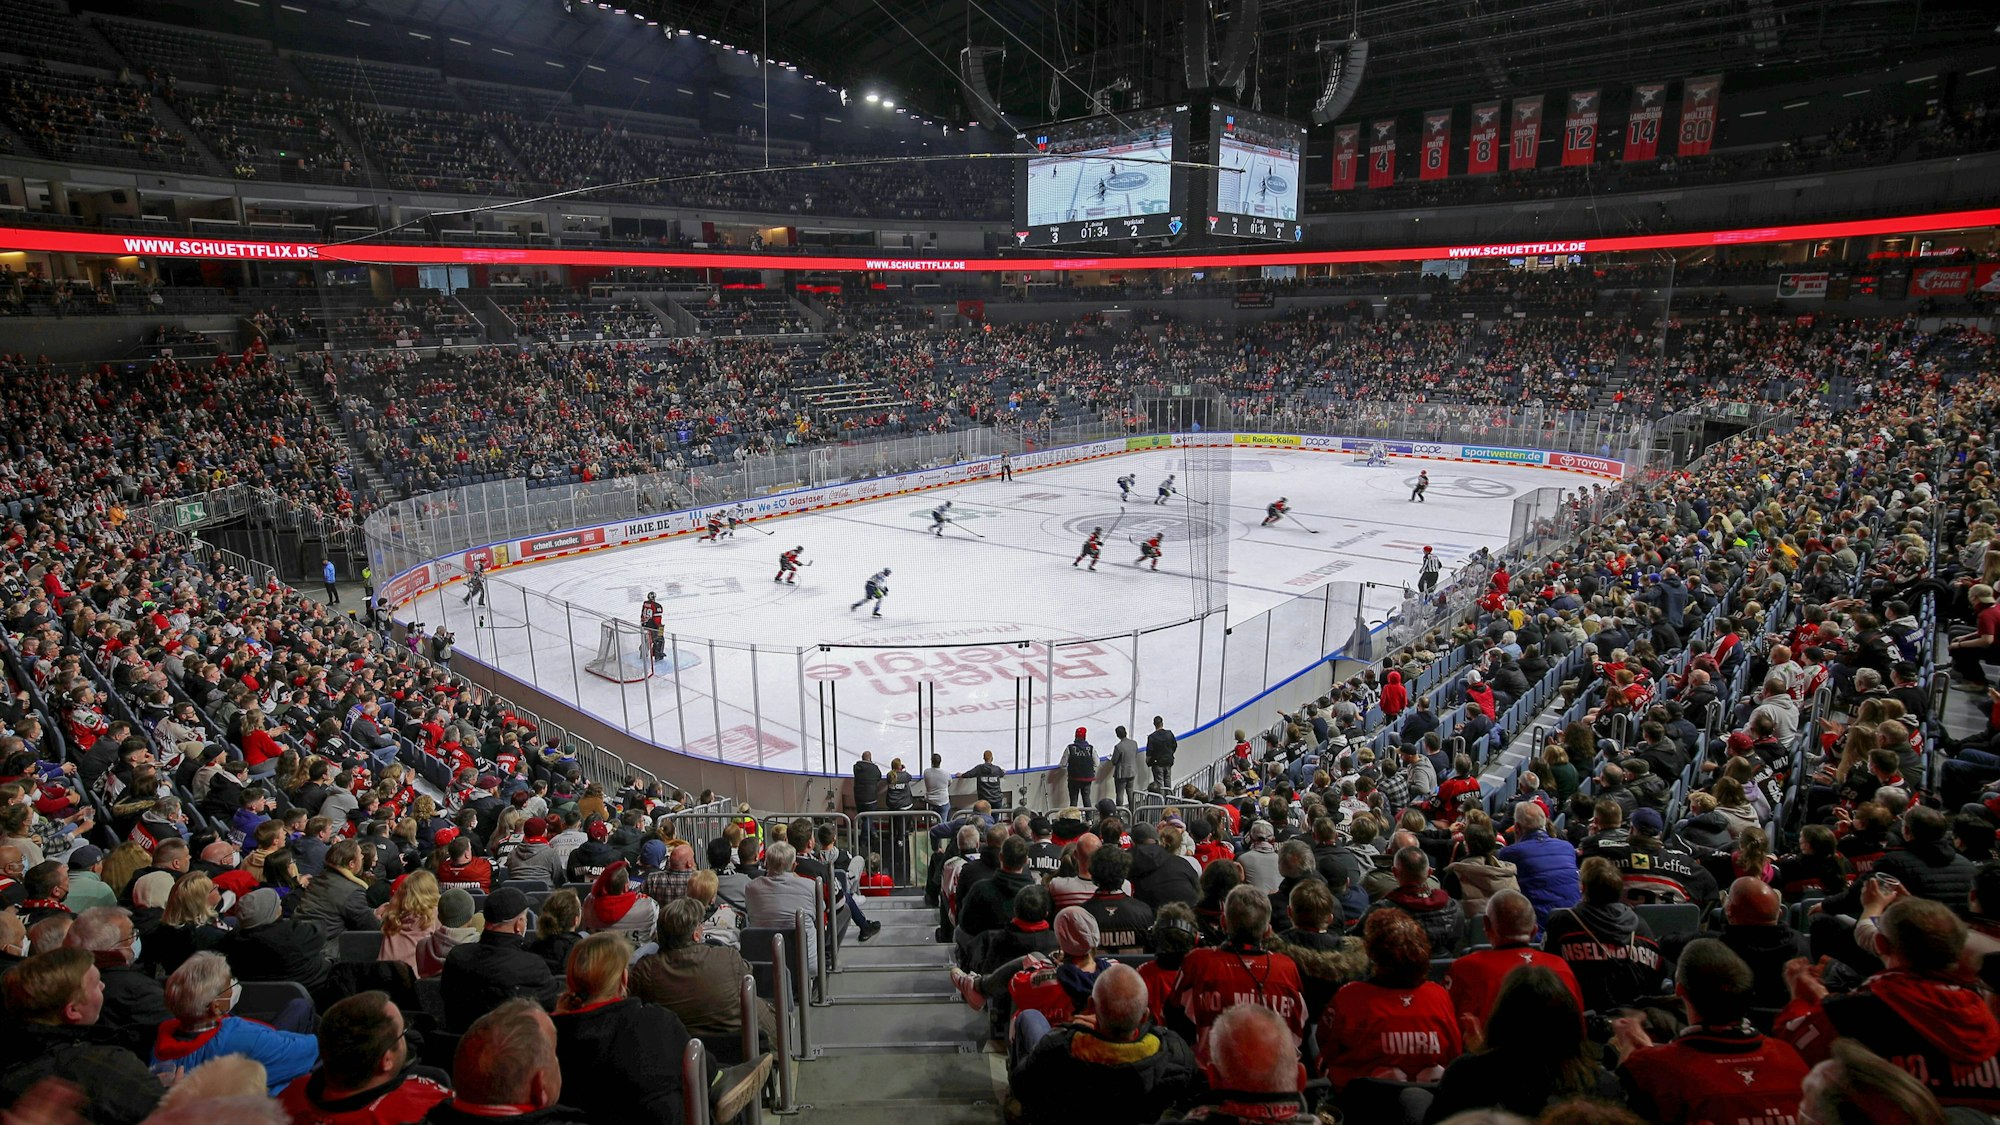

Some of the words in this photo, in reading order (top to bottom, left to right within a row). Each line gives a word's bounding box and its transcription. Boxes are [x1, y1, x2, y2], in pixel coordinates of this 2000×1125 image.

[1568, 125, 1593, 150] 12
[1631, 119, 1658, 144] 14
[1681, 119, 1712, 144] 80
[1477, 140, 1490, 162] 8
[1514, 135, 1535, 158] 11
[1376, 151, 1389, 173] 4
[1427, 148, 1441, 170] 6
[1340, 160, 1348, 180] 1
[1052, 232, 1059, 243] 3
[1081, 226, 1109, 238] 01:34
[1131, 225, 1138, 237] 2
[1233, 223, 1238, 234] 3
[1250, 223, 1267, 235] 01:34
[1277, 228, 1281, 238] 2
[123, 239, 319, 259] WWW.SCHUETTFLIX.DE
[1448, 241, 1586, 258] WWW.SCHUETTFLIX.DE
[866, 260, 966, 270] WWW.SCHUETTFLIX.DE
[1934, 270, 1967, 281] FIDELE
[1932, 280, 1961, 289] HAIE
[1252, 436, 1273, 444] Radio
[1276, 437, 1294, 445] Köln
[1305, 437, 1330, 447] pape
[1414, 444, 1442, 455] pape
[1464, 448, 1541, 462] sportwetten.de
[1026, 453, 1055, 466] DANKE
[1576, 458, 1608, 471] TOYOTA
[757, 503, 771, 512] We
[789, 493, 824, 506] Glasfaser
[629, 519, 670, 536] HAIE.DE
[533, 540, 554, 551] schnell.
[554, 536, 580, 547] schneller.
[470, 551, 487, 561] Time
[806, 636, 1108, 681] Energie
[868, 658, 1110, 696] Rhein
[892, 687, 1118, 722] RheinEnergie
[1100, 931, 1136, 946] ULIAN
[1381, 1030, 1441, 1055] UVIRA
